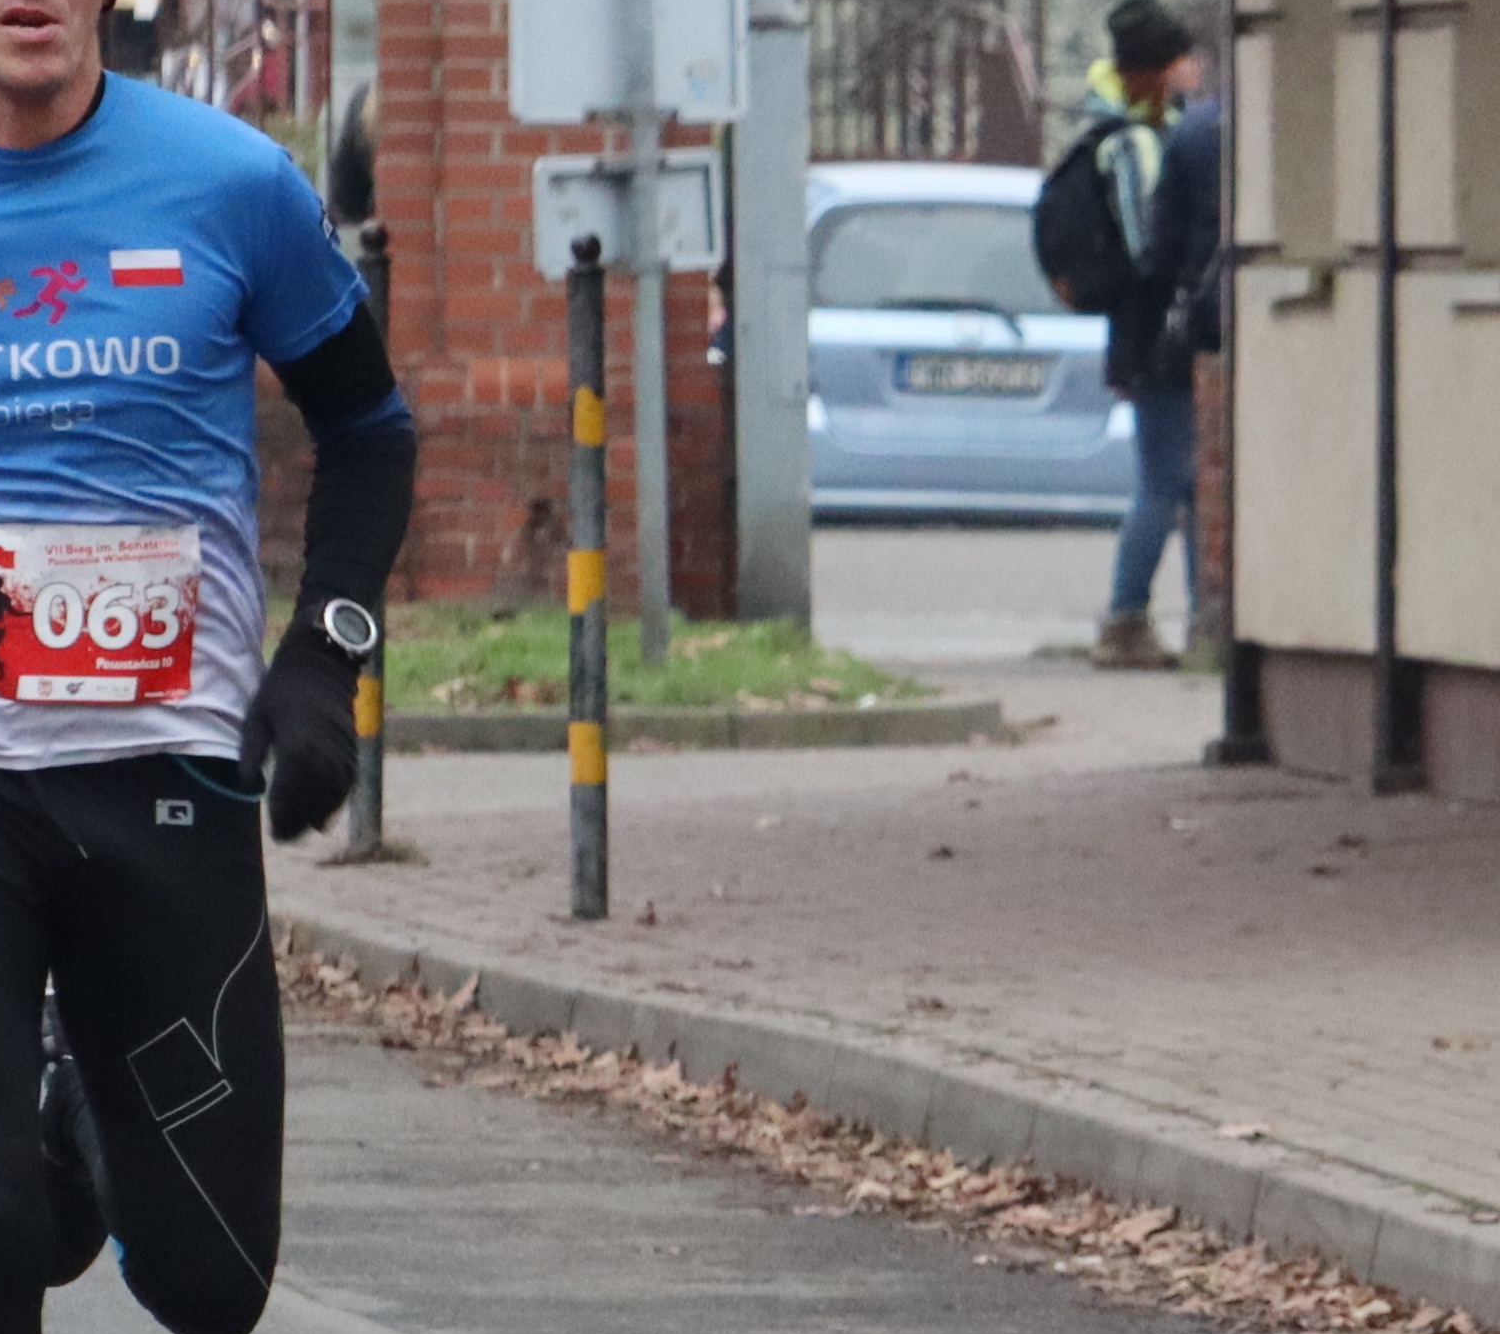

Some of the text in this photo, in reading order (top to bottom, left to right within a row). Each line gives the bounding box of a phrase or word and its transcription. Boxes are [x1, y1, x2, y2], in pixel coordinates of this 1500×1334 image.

[45, 544, 63, 556] VII
[66, 543, 93, 557] Bieg
[32, 581, 182, 651] 063
